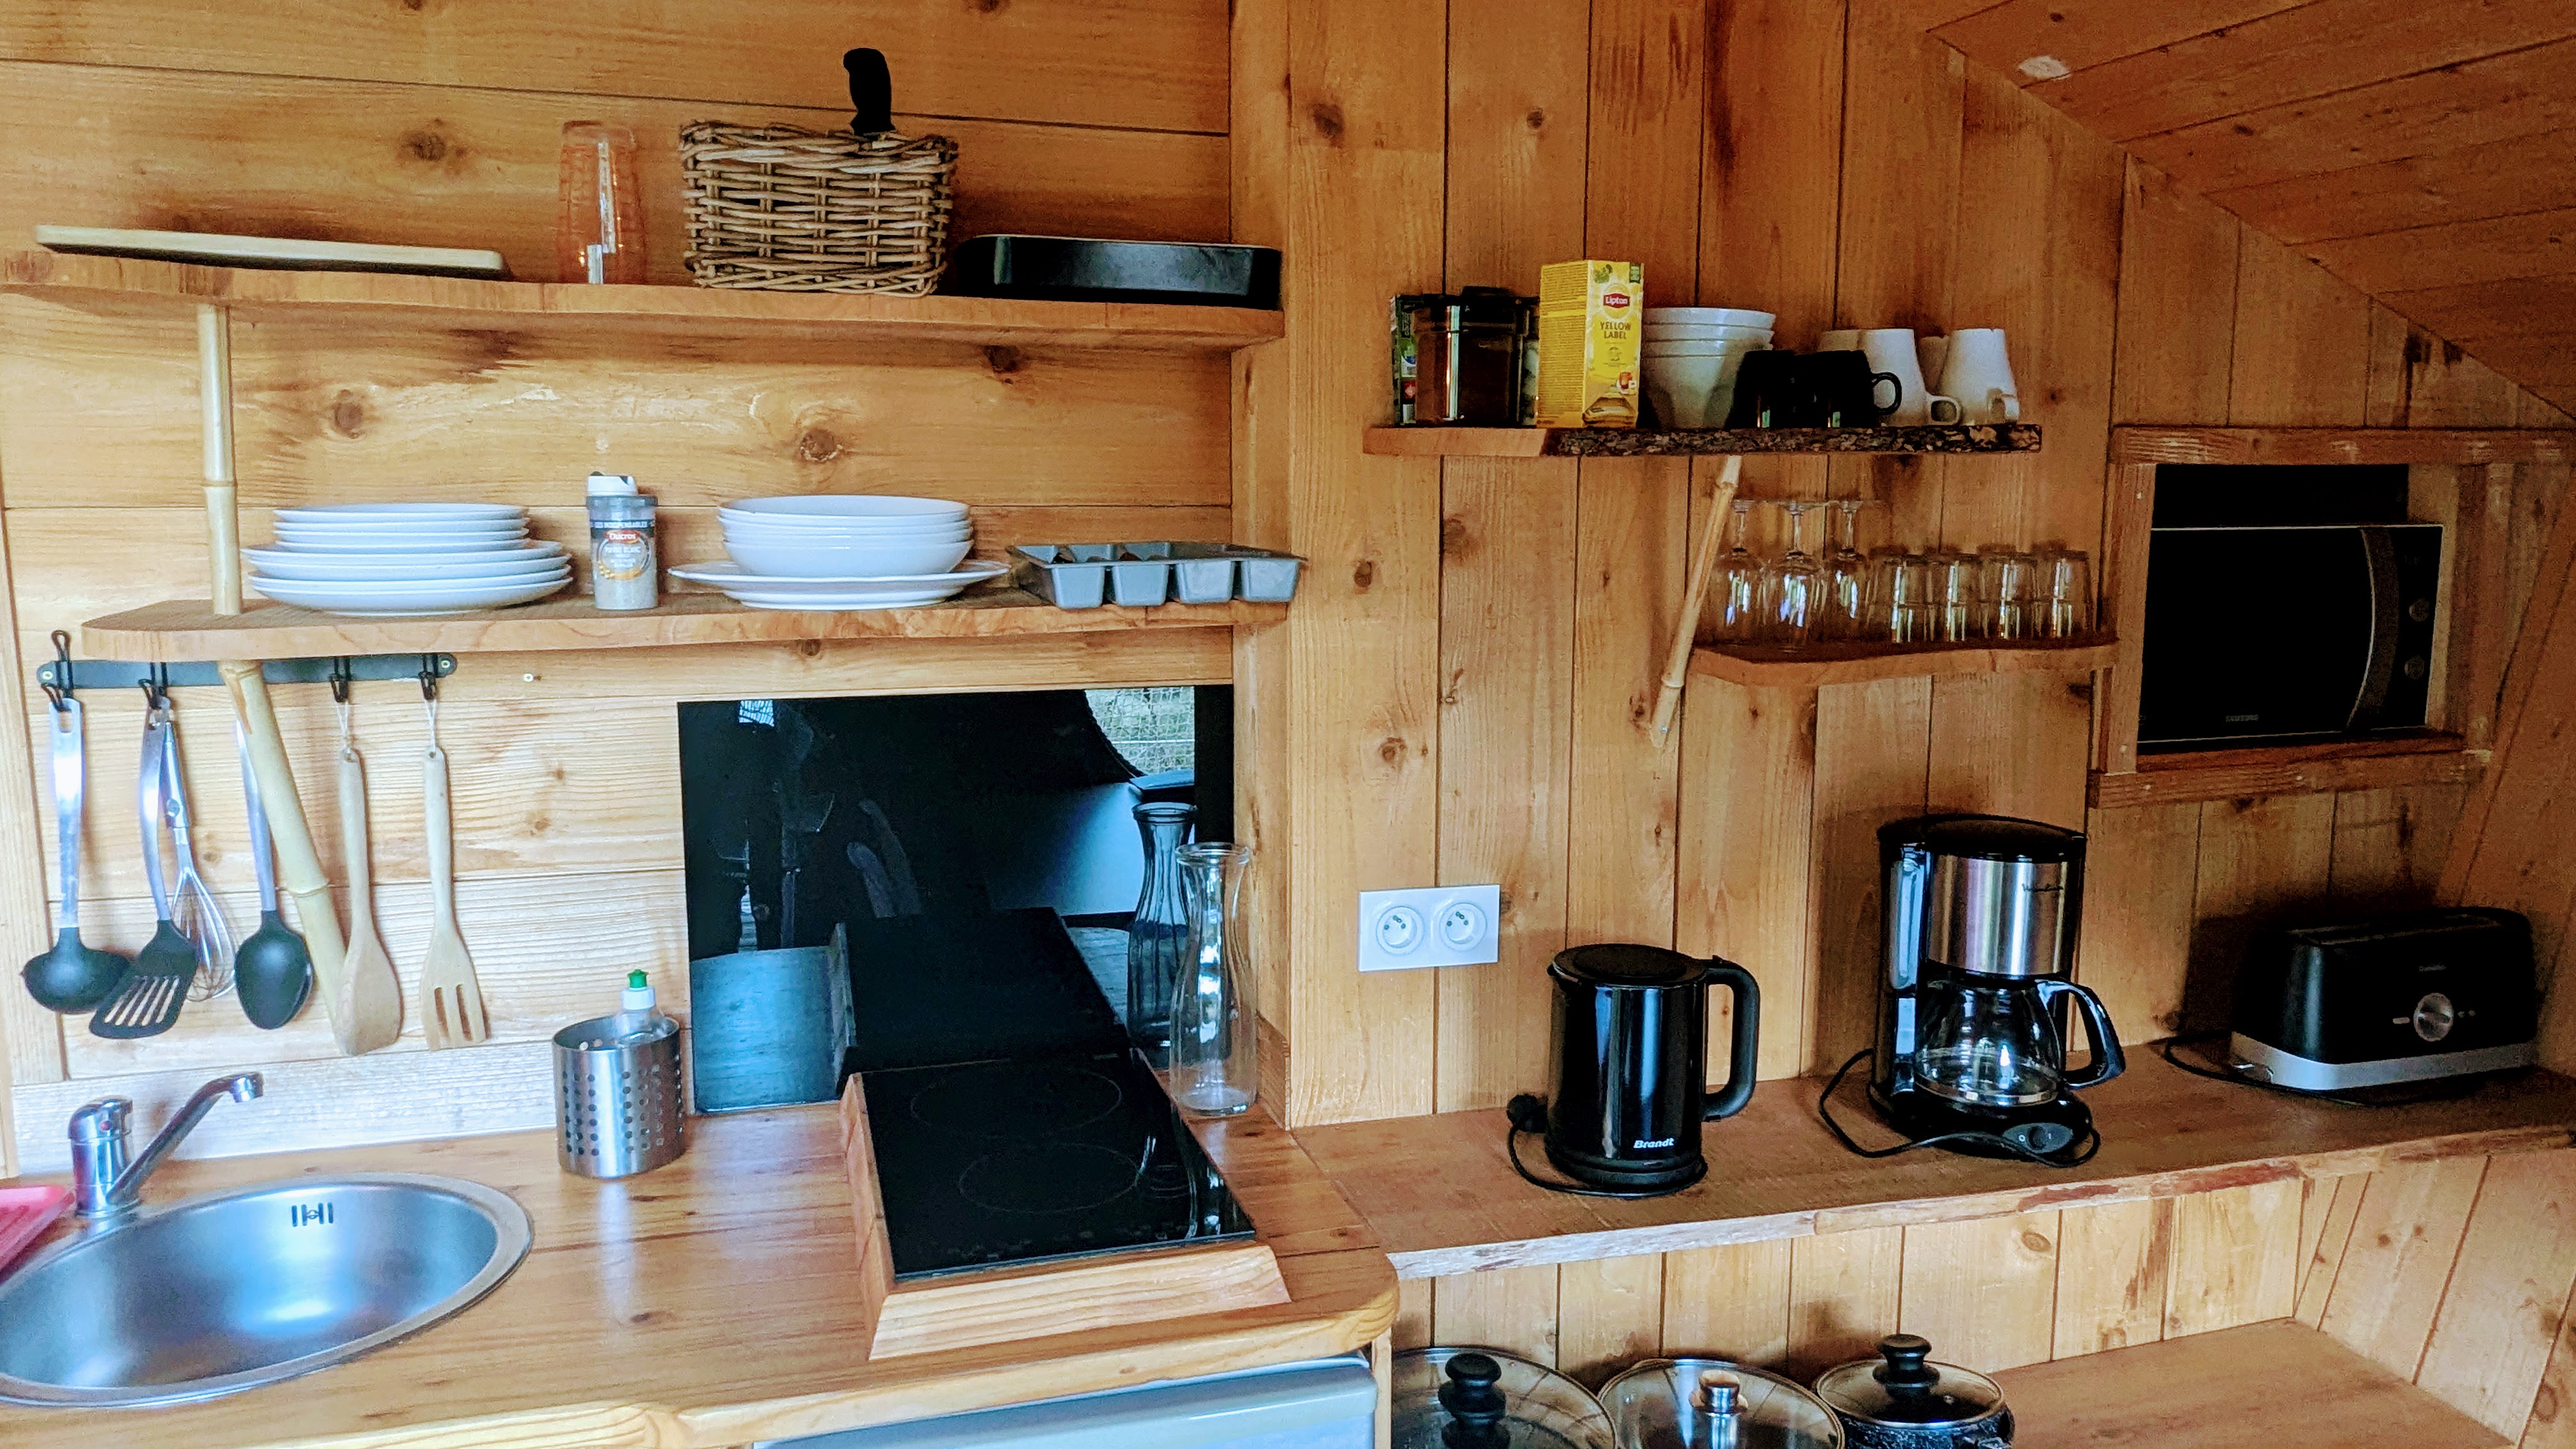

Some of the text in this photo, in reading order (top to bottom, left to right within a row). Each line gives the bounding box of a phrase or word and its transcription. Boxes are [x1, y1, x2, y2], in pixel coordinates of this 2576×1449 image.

[1606, 296, 1629, 305] Lipton
[1600, 321, 1631, 332] YELLOW
[1604, 331, 1627, 339] LABEL
[1633, 1137, 1675, 1149] Brandt
